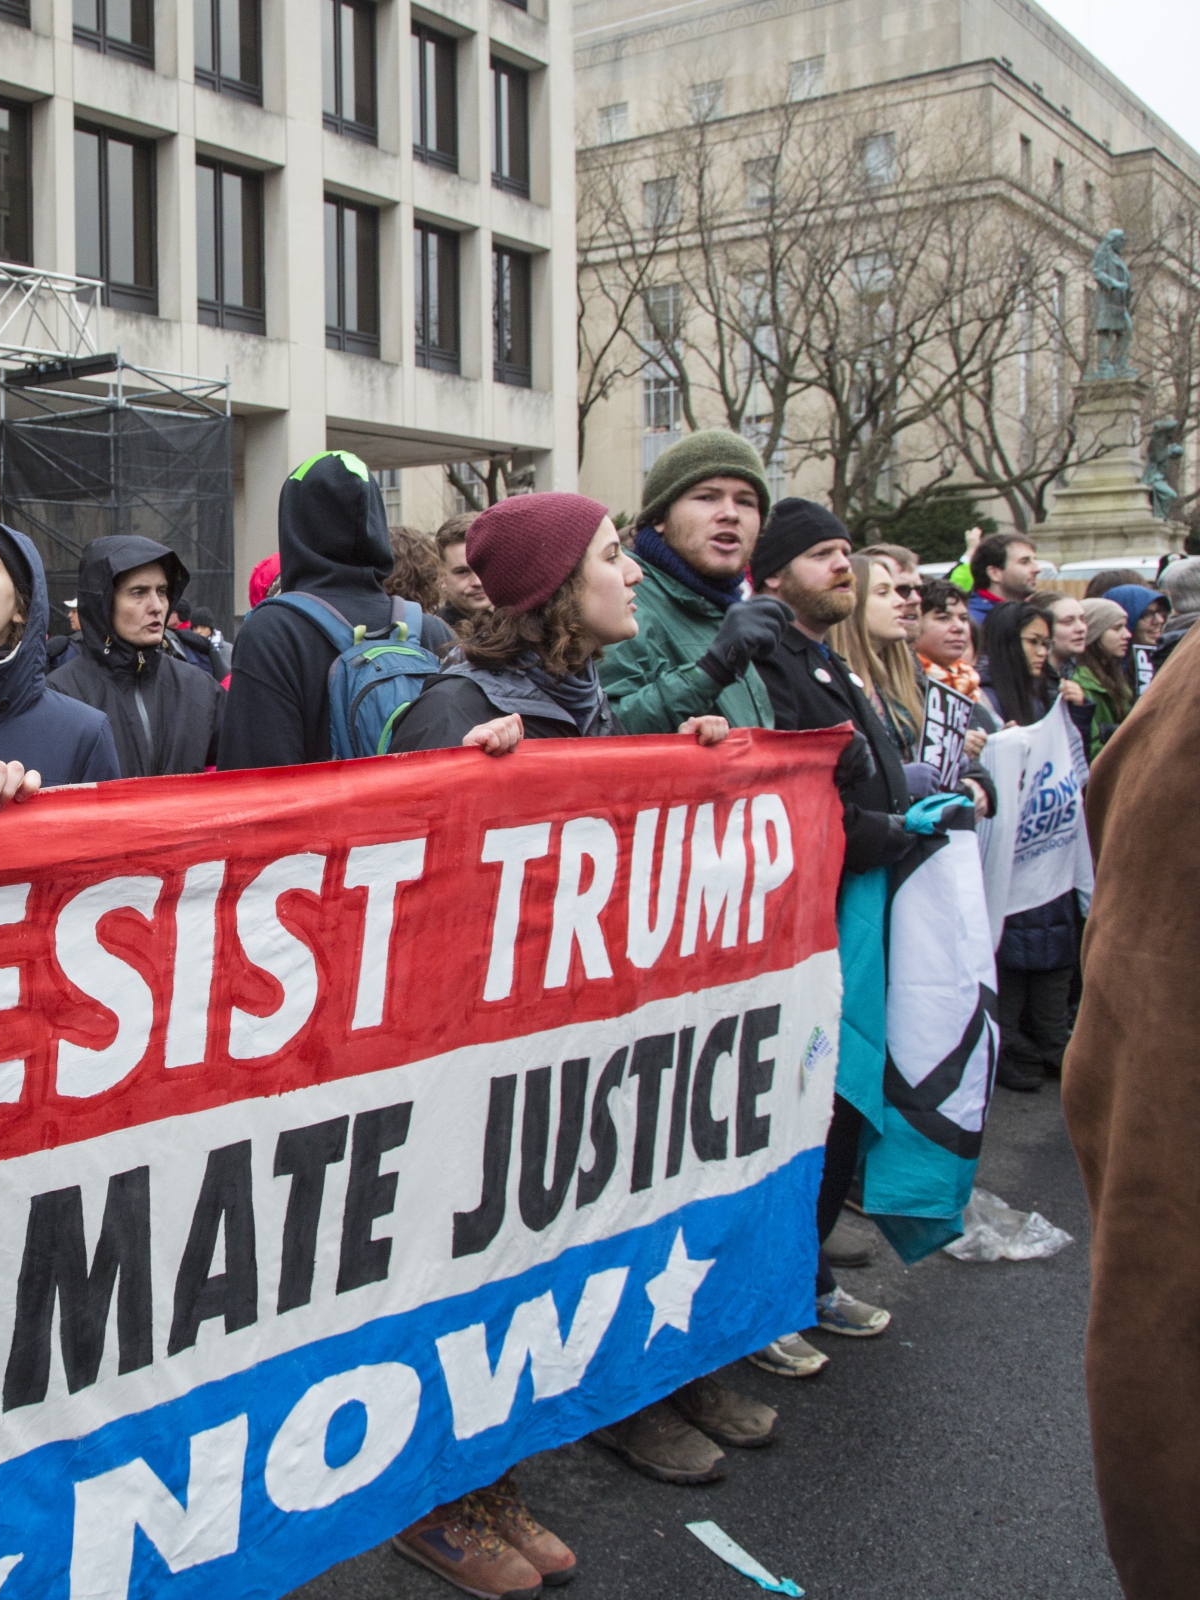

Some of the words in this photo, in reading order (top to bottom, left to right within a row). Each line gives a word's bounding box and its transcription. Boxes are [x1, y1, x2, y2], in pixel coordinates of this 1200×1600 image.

[481, 794, 794, 1002] TRUMP
[452, 1004, 780, 1258] JUSTICE
[70, 1266, 628, 1600] NOW
